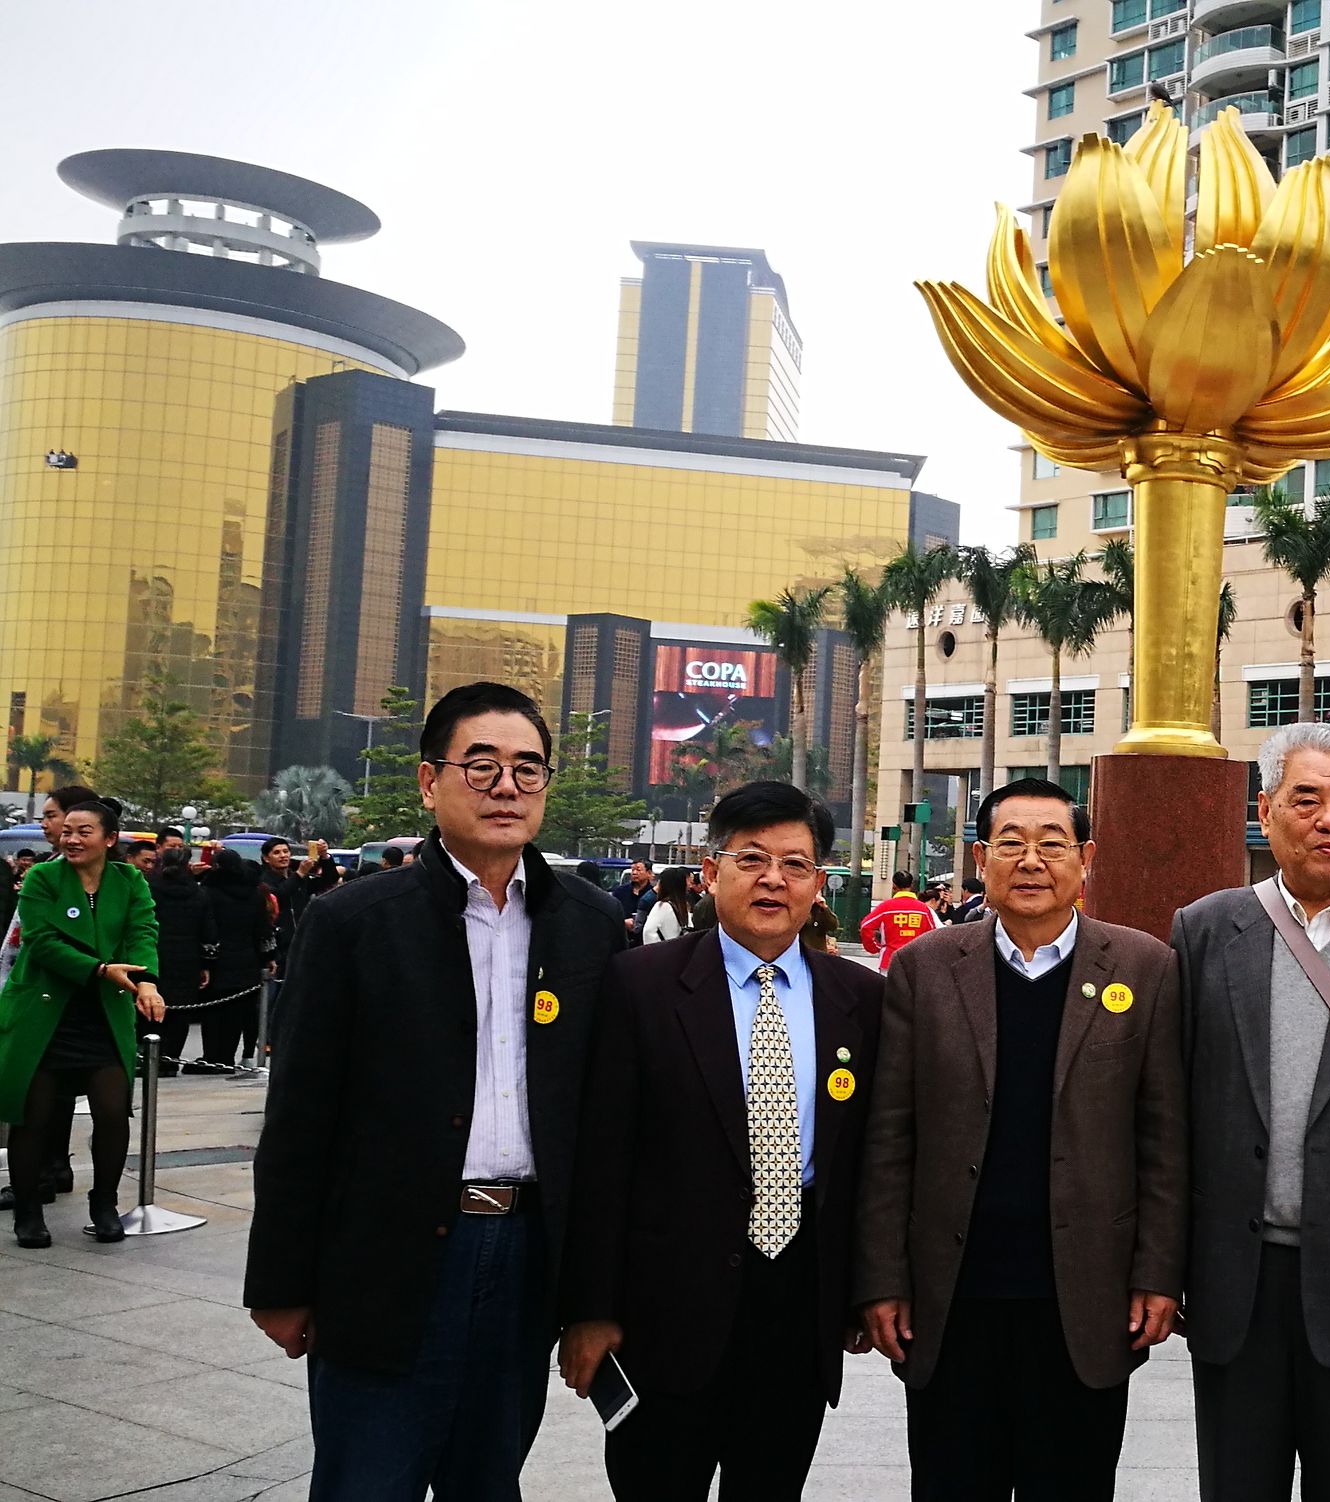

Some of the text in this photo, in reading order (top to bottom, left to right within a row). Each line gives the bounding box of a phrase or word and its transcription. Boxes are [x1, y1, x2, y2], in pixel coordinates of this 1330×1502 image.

[686, 661, 747, 681] COPA
[685, 679, 747, 689] STEAKHOUSE
[893, 913, 922, 928] 中国
[1110, 991, 1126, 1002] 98
[537, 998, 553, 1012] 98
[835, 1076, 849, 1089] 98
